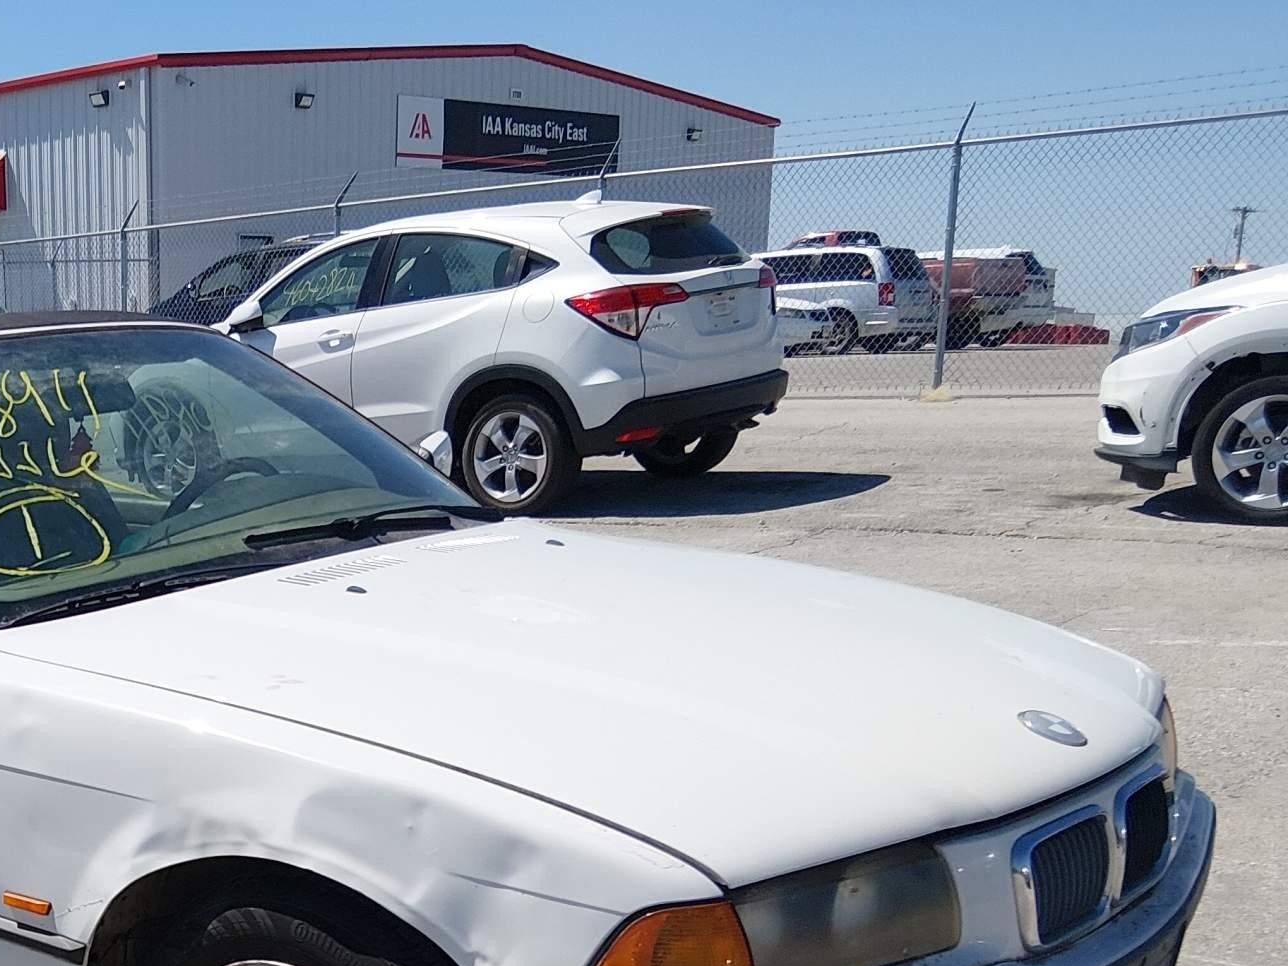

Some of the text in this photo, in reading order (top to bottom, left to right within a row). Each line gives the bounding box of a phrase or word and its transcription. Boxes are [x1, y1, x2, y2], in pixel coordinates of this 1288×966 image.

[482, 115, 588, 145] IAA Kansas City East
